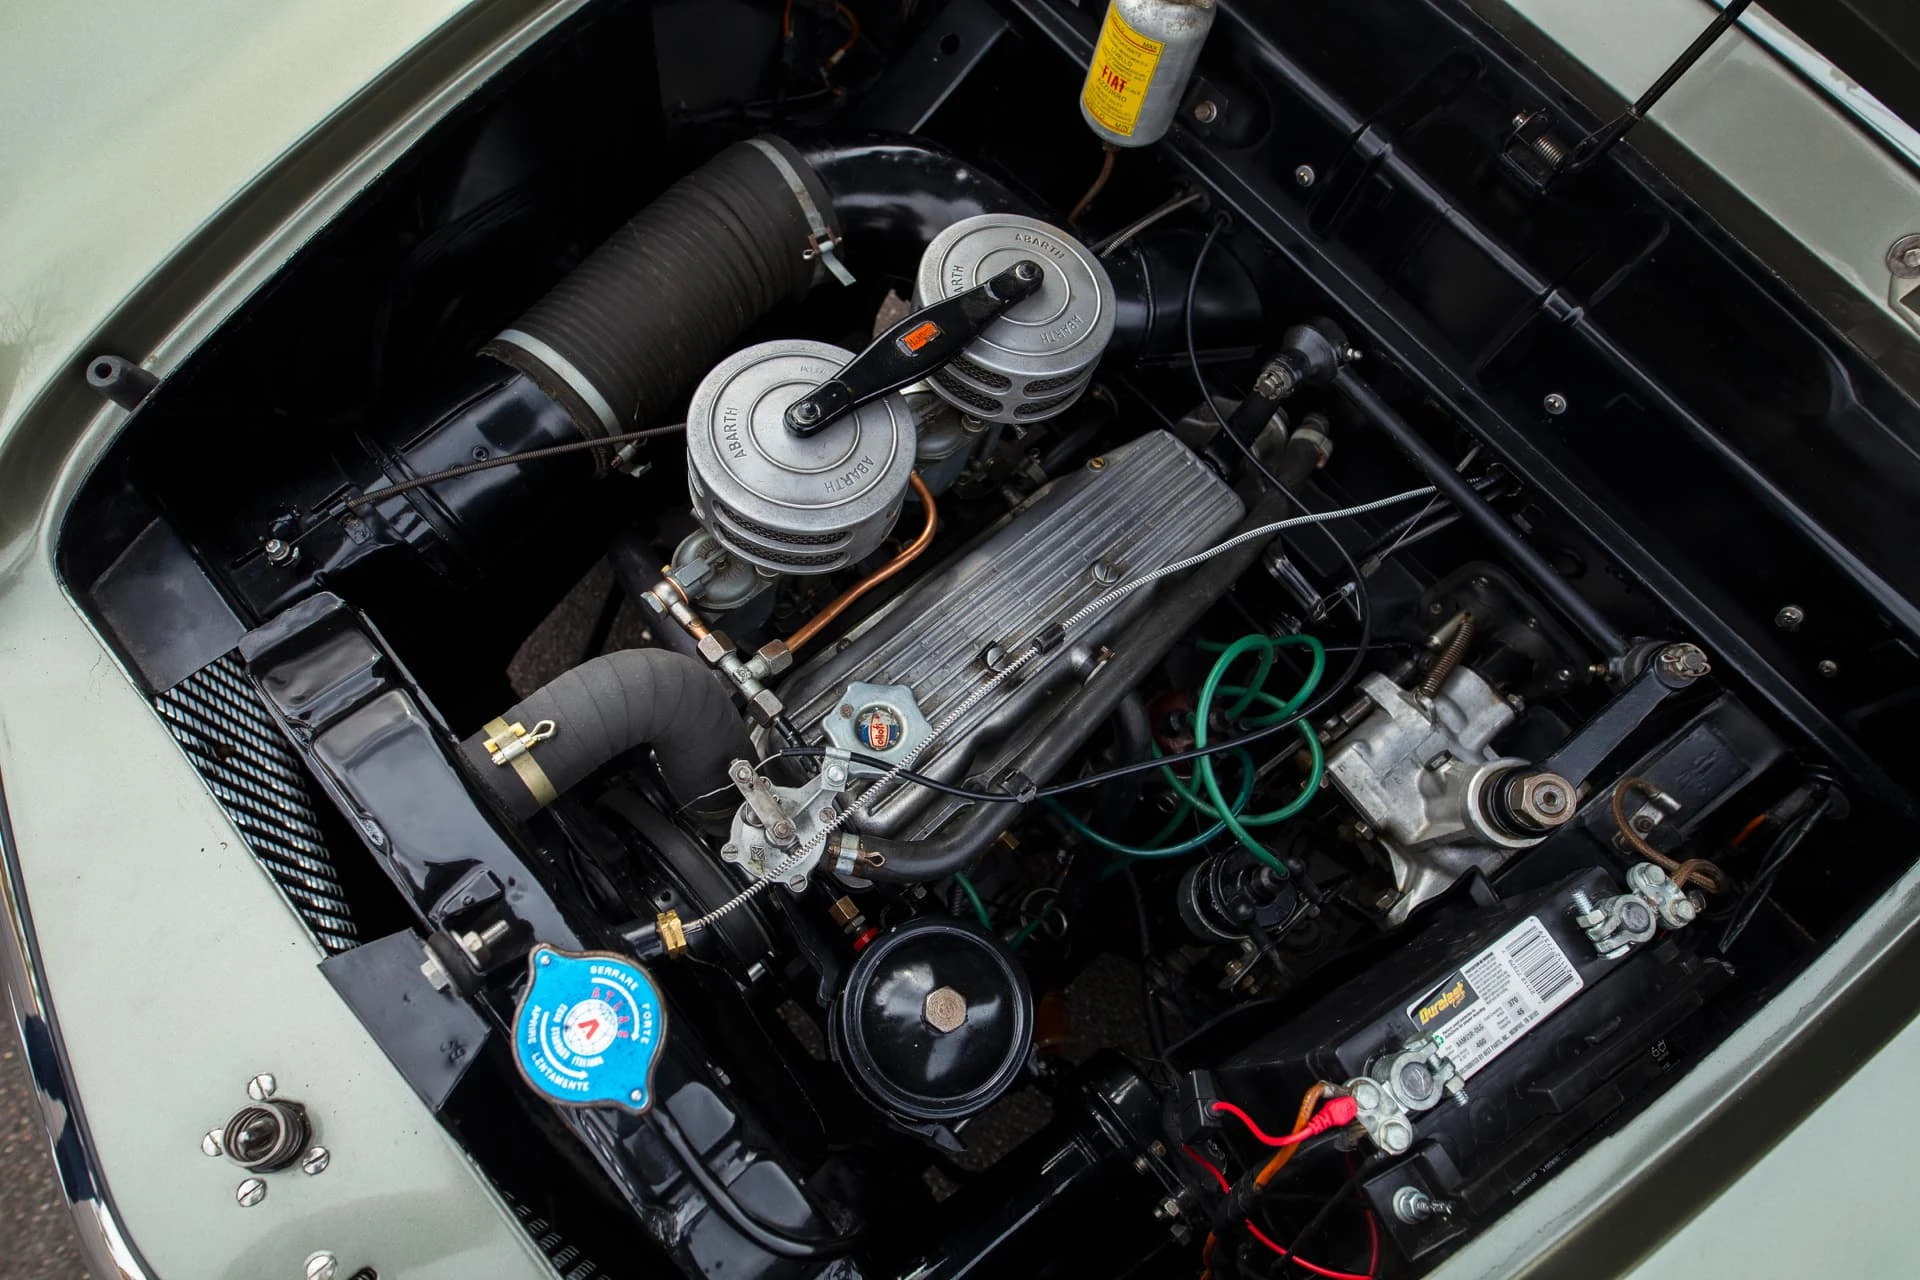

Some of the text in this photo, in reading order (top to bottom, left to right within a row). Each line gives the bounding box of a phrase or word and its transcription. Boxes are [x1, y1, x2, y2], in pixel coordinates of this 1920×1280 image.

[1101, 65, 1127, 93] FIAT
[1015, 232, 1065, 260] ABARTH
[952, 264, 964, 293] ARTH
[1040, 313, 1083, 345] ABARTH
[723, 407, 748, 459] ABARTH
[823, 455, 875, 494] ABARTH
[590, 965, 650, 1045] SERRARE FORTE
[1418, 980, 1466, 1025] Duralast
[1507, 997, 1519, 1008] 370
[1516, 1008, 1525, 1017] 45
[527, 1004, 542, 1045] APRIRE
[531, 1051, 590, 1092] LENTAMENTE
